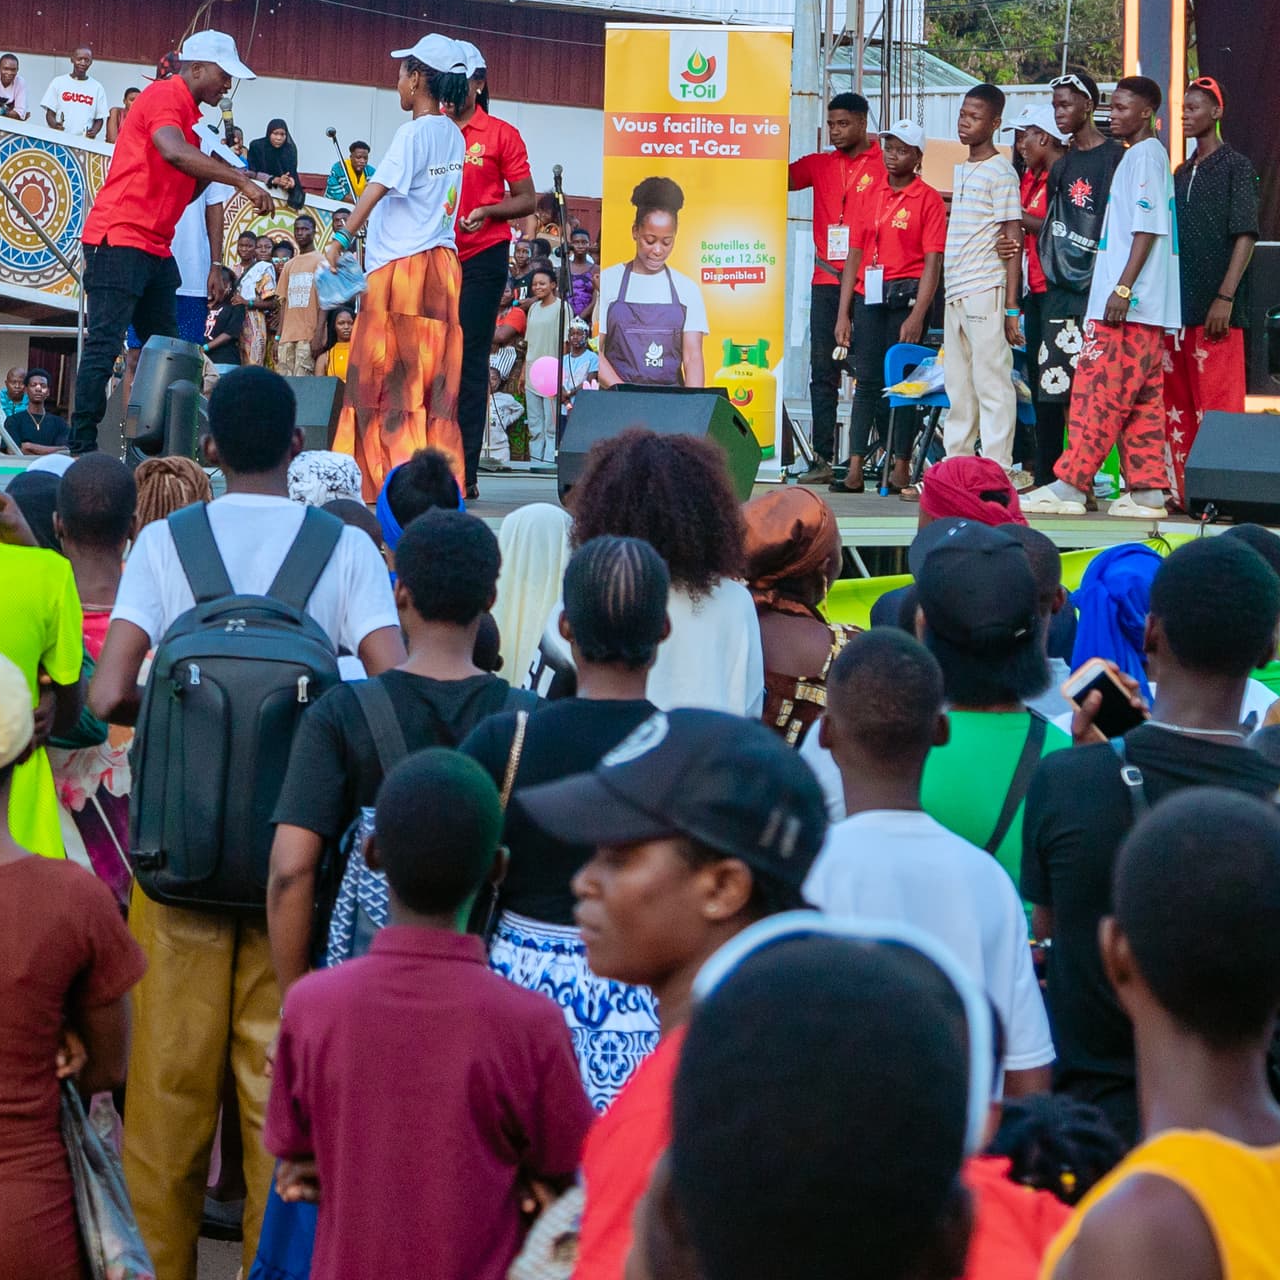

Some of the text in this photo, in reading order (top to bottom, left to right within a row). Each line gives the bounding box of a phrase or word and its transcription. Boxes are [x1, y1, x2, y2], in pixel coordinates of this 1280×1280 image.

[679, 84, 717, 99] T-Oil
[611, 116, 781, 135] Vous facilite la vie
[640, 139, 741, 157] avec T-Gaz
[701, 239, 766, 250] Bouteilles de
[701, 253, 776, 266] 6Kg et 12,5Kg
[703, 270, 758, 283] Disponibles
